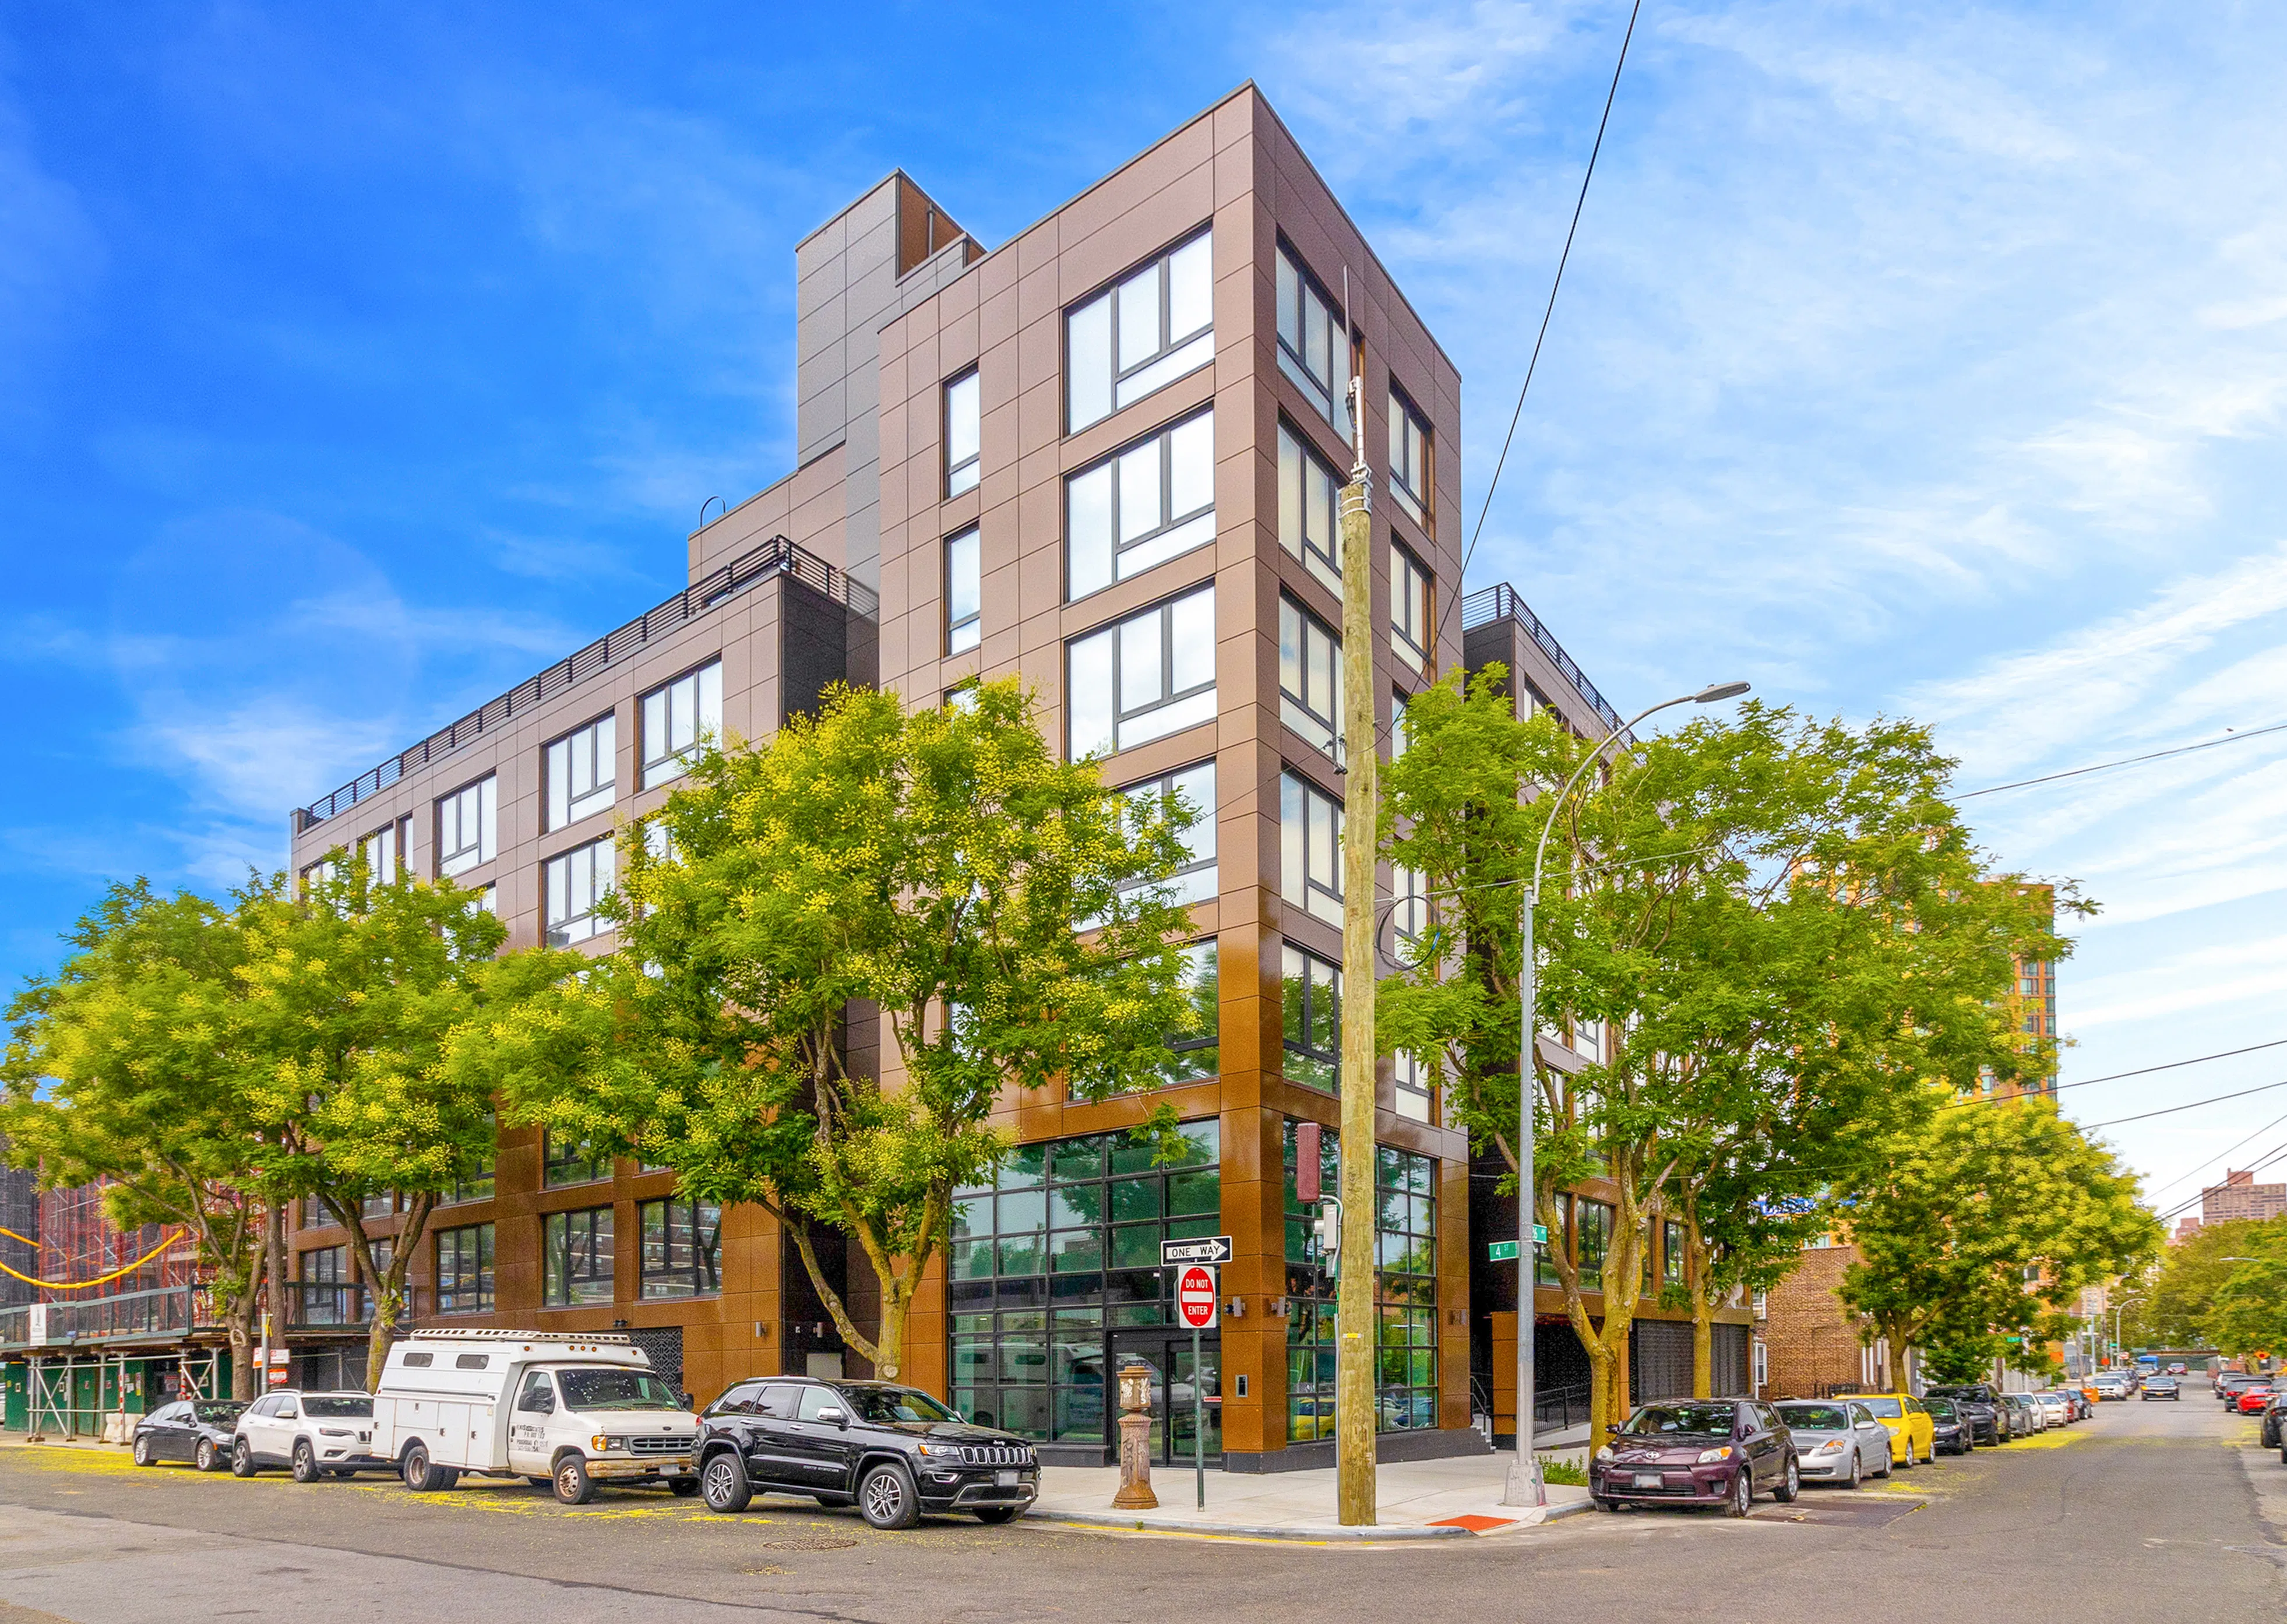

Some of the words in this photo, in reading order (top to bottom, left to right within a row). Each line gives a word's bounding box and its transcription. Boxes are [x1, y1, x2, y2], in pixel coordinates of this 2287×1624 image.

[1172, 1248, 1191, 1257] ONE
[1200, 1245, 1220, 1255] WAY
[1496, 1245, 1501, 1257] 4
[1186, 1278, 1194, 1288] DO
[1196, 1279, 1208, 1288] NOT
[1188, 1306, 1208, 1315] ENTER
